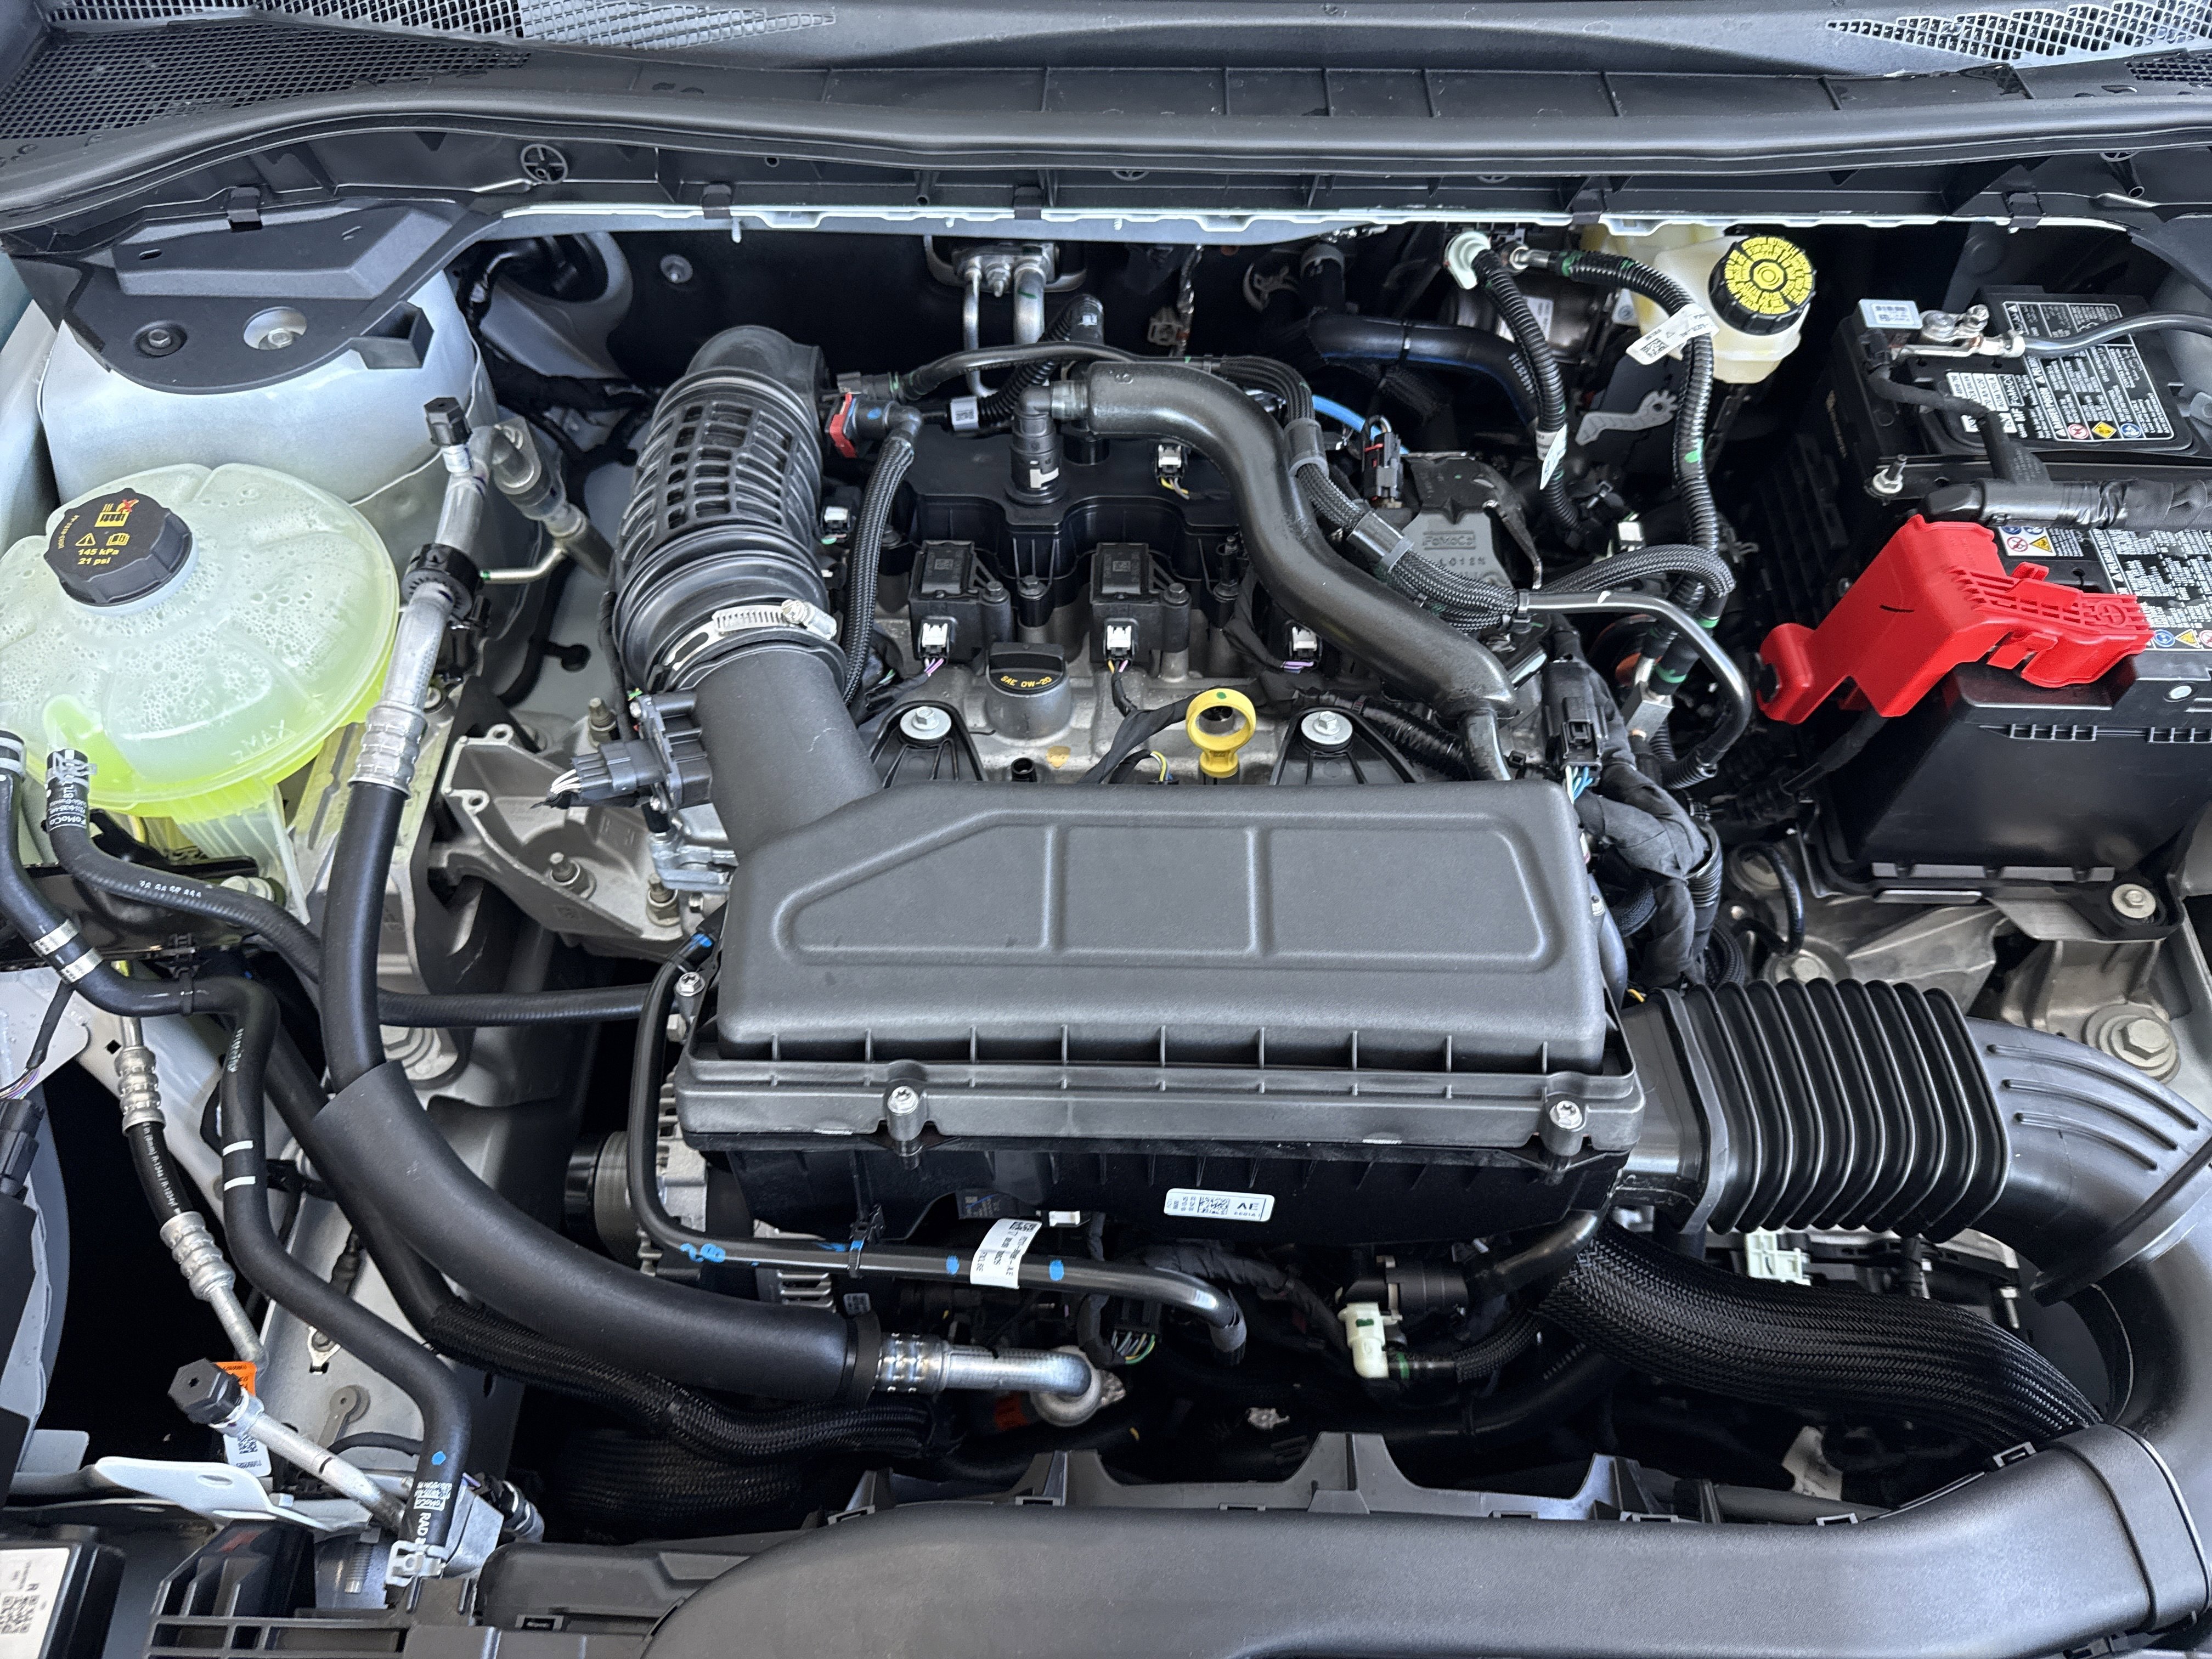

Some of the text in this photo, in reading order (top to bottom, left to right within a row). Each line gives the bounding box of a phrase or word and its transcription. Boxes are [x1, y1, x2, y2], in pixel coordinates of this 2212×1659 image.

[93, 557, 111, 566] psi
[1000, 675, 1052, 687] SAE 0W-20
[241, 719, 297, 757] MAX
[49, 815, 87, 826] FoMoCo
[1237, 1203, 1260, 1211] AE
[417, 1512, 432, 1536] RAD
